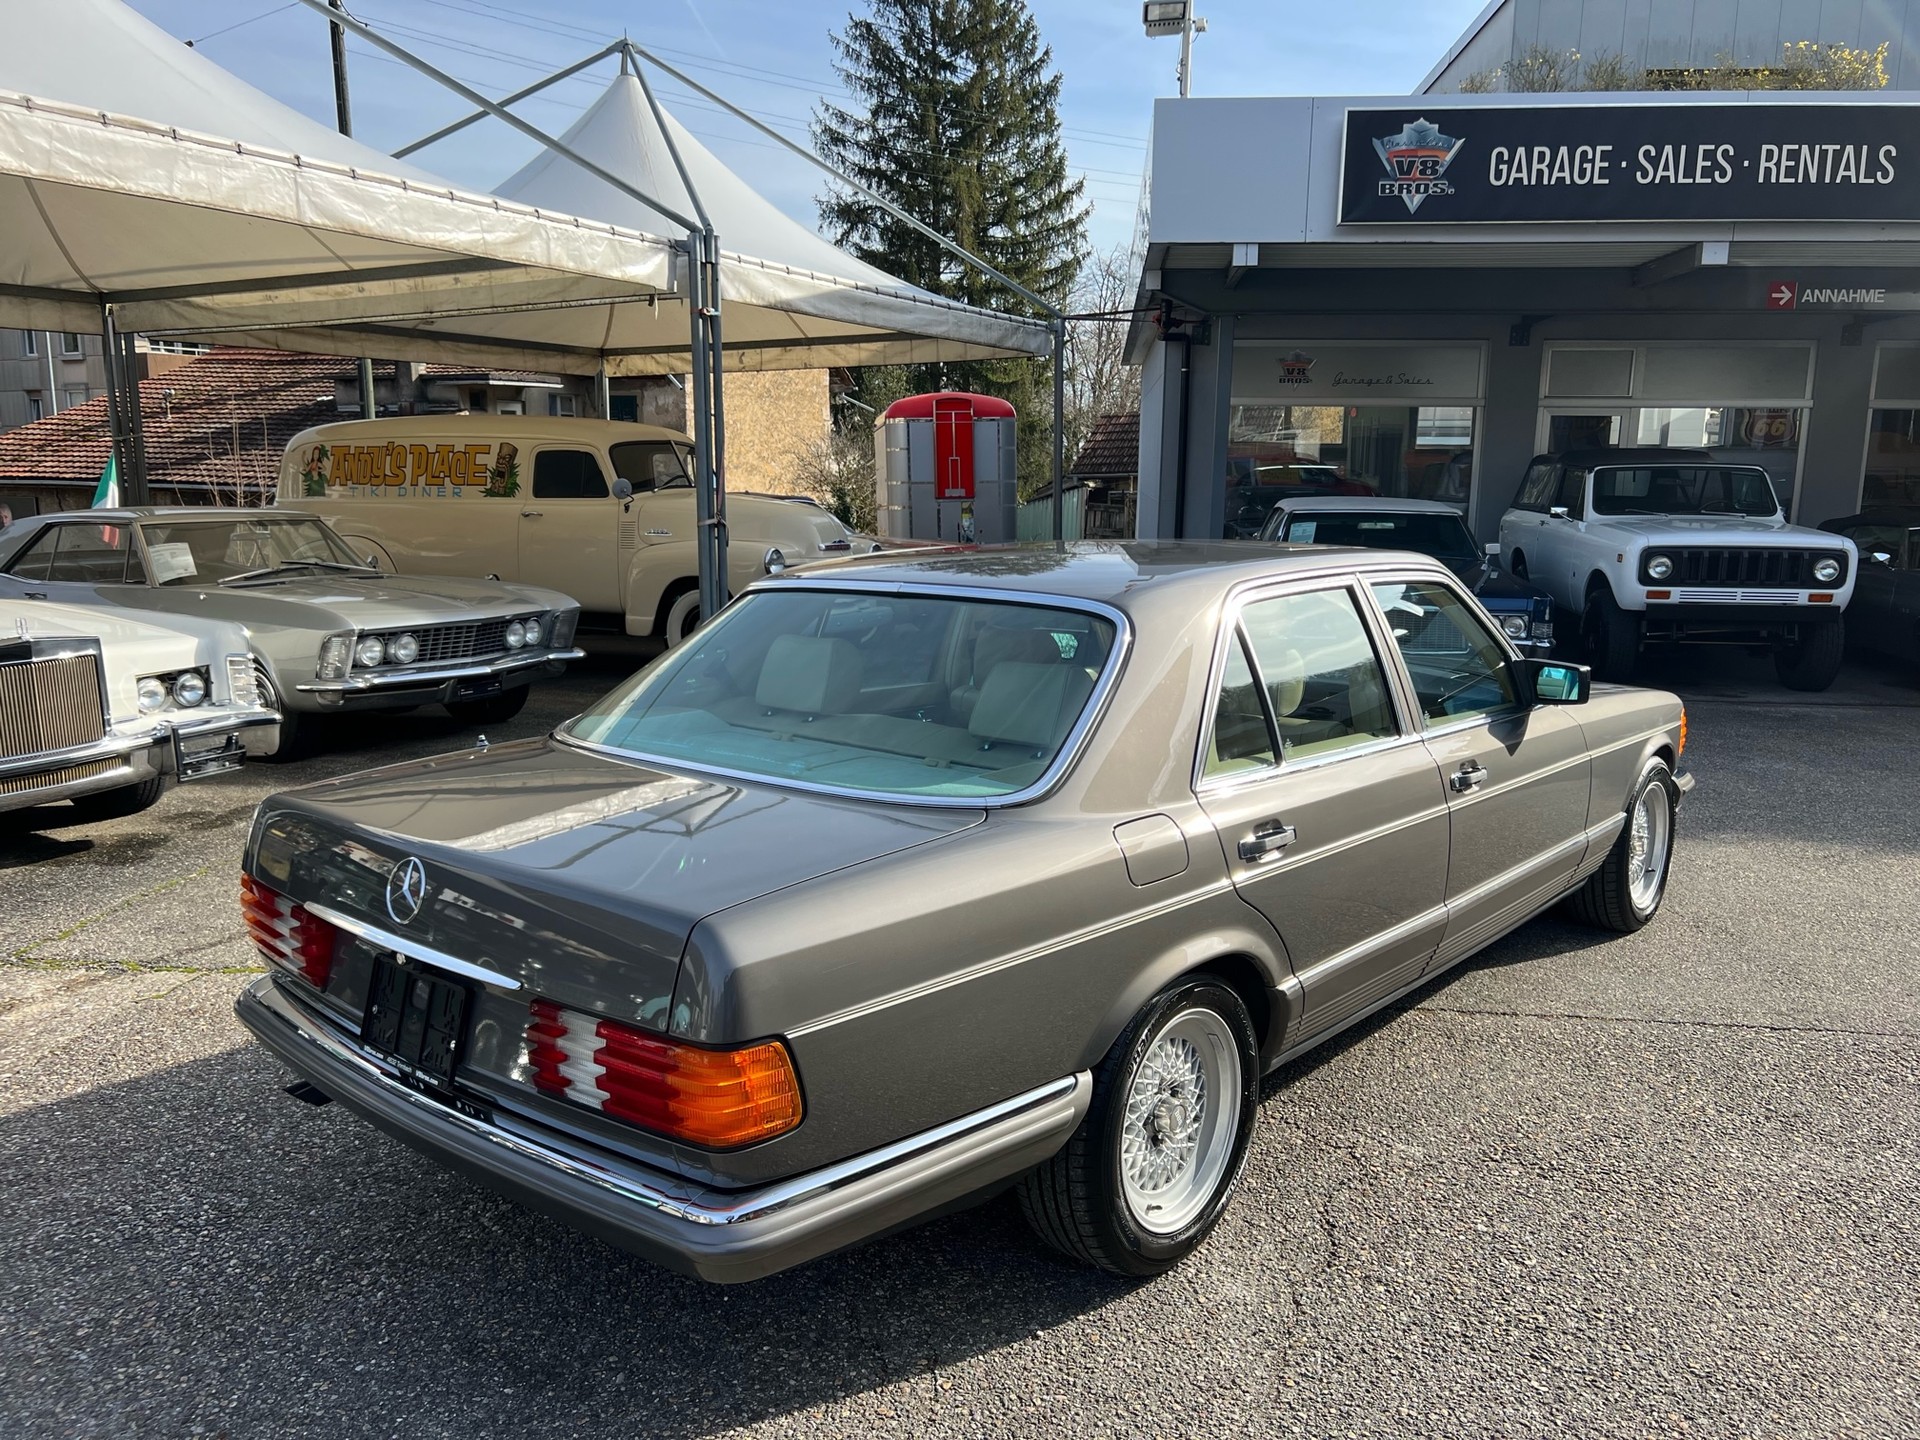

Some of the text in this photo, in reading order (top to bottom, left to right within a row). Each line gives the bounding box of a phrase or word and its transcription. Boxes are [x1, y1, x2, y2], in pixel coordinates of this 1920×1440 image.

[1392, 156, 1441, 178] V8
[1489, 143, 1896, 186] GARAGE SALES RENTALS
[1801, 289, 1885, 304] ANNAHME
[1285, 367, 1307, 376] V8
[1332, 371, 1434, 387] Garage & Sales
[1754, 418, 1786, 435] 66
[330, 441, 491, 487] ANDY'S PLACE
[348, 487, 463, 498] TIKI DINER
